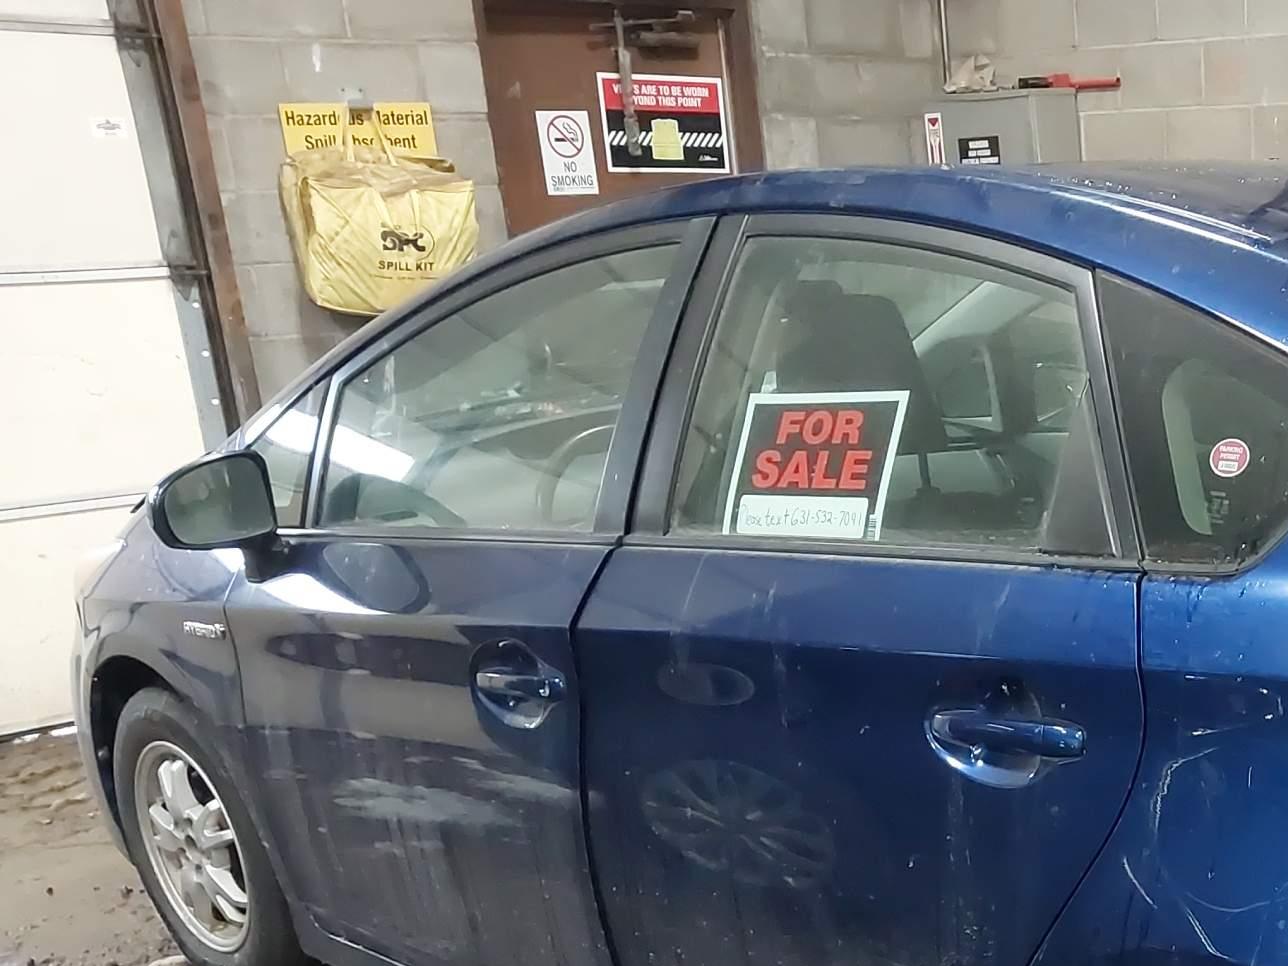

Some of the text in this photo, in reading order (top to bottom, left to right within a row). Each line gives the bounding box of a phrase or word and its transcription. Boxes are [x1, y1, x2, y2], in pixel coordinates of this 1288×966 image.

[658, 86, 670, 95] TO
[683, 87, 709, 97] WORN
[632, 95, 702, 107] YOND THIS POINT
[284, 110, 364, 126] Hazardus
[563, 161, 577, 173] NO
[551, 174, 594, 187] SMOKING
[378, 260, 435, 272] SPILL KIT
[775, 410, 864, 445] FOR
[751, 450, 873, 489] SALE
